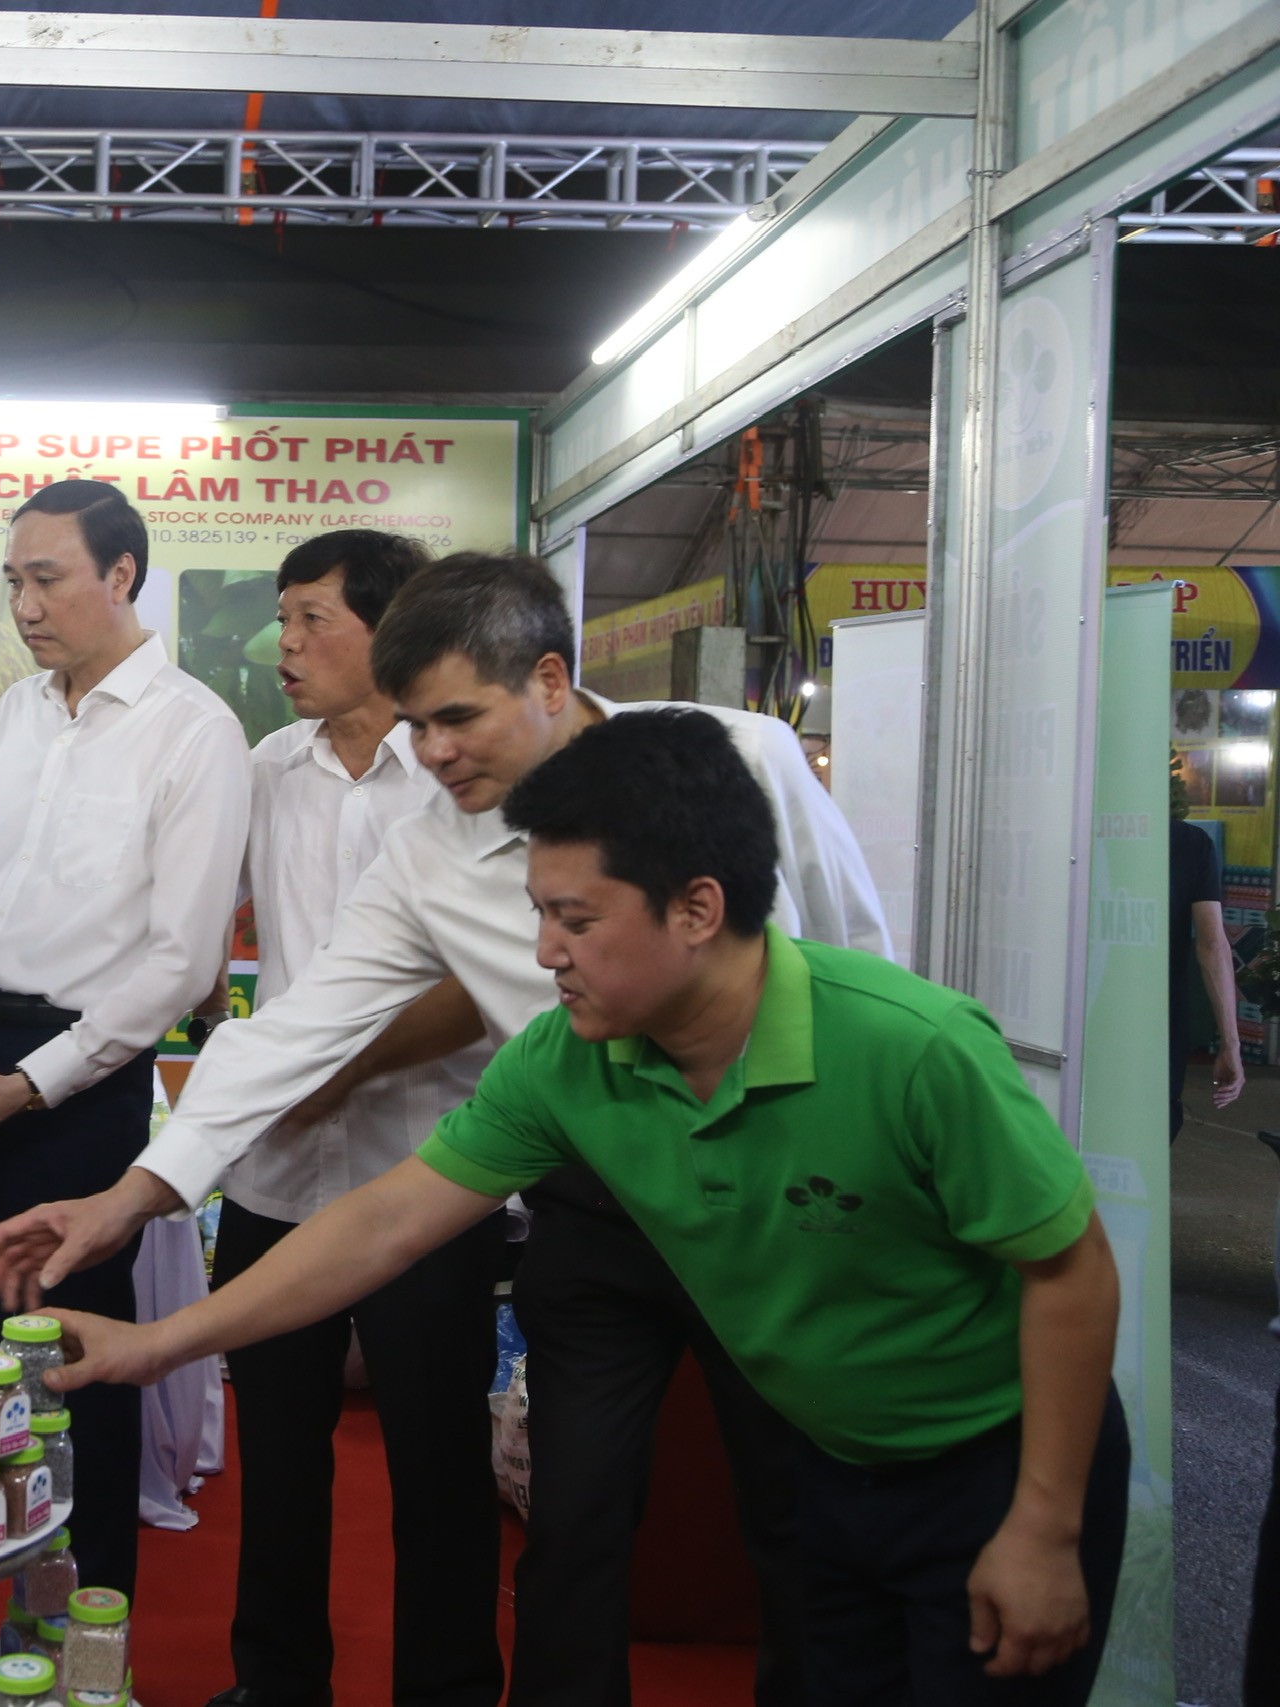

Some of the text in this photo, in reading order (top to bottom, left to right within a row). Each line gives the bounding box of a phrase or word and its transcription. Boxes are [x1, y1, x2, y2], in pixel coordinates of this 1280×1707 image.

[38, 434, 161, 460] SUPE
[180, 426, 310, 462] PHỐT
[325, 432, 455, 464] PHÁT
[136, 470, 239, 502] LÂM
[255, 477, 391, 505] THAO
[214, 511, 314, 526] COMPANY
[320, 513, 452, 528] (LAFCHEMCO)
[1171, 627, 1232, 672] RIỂN
